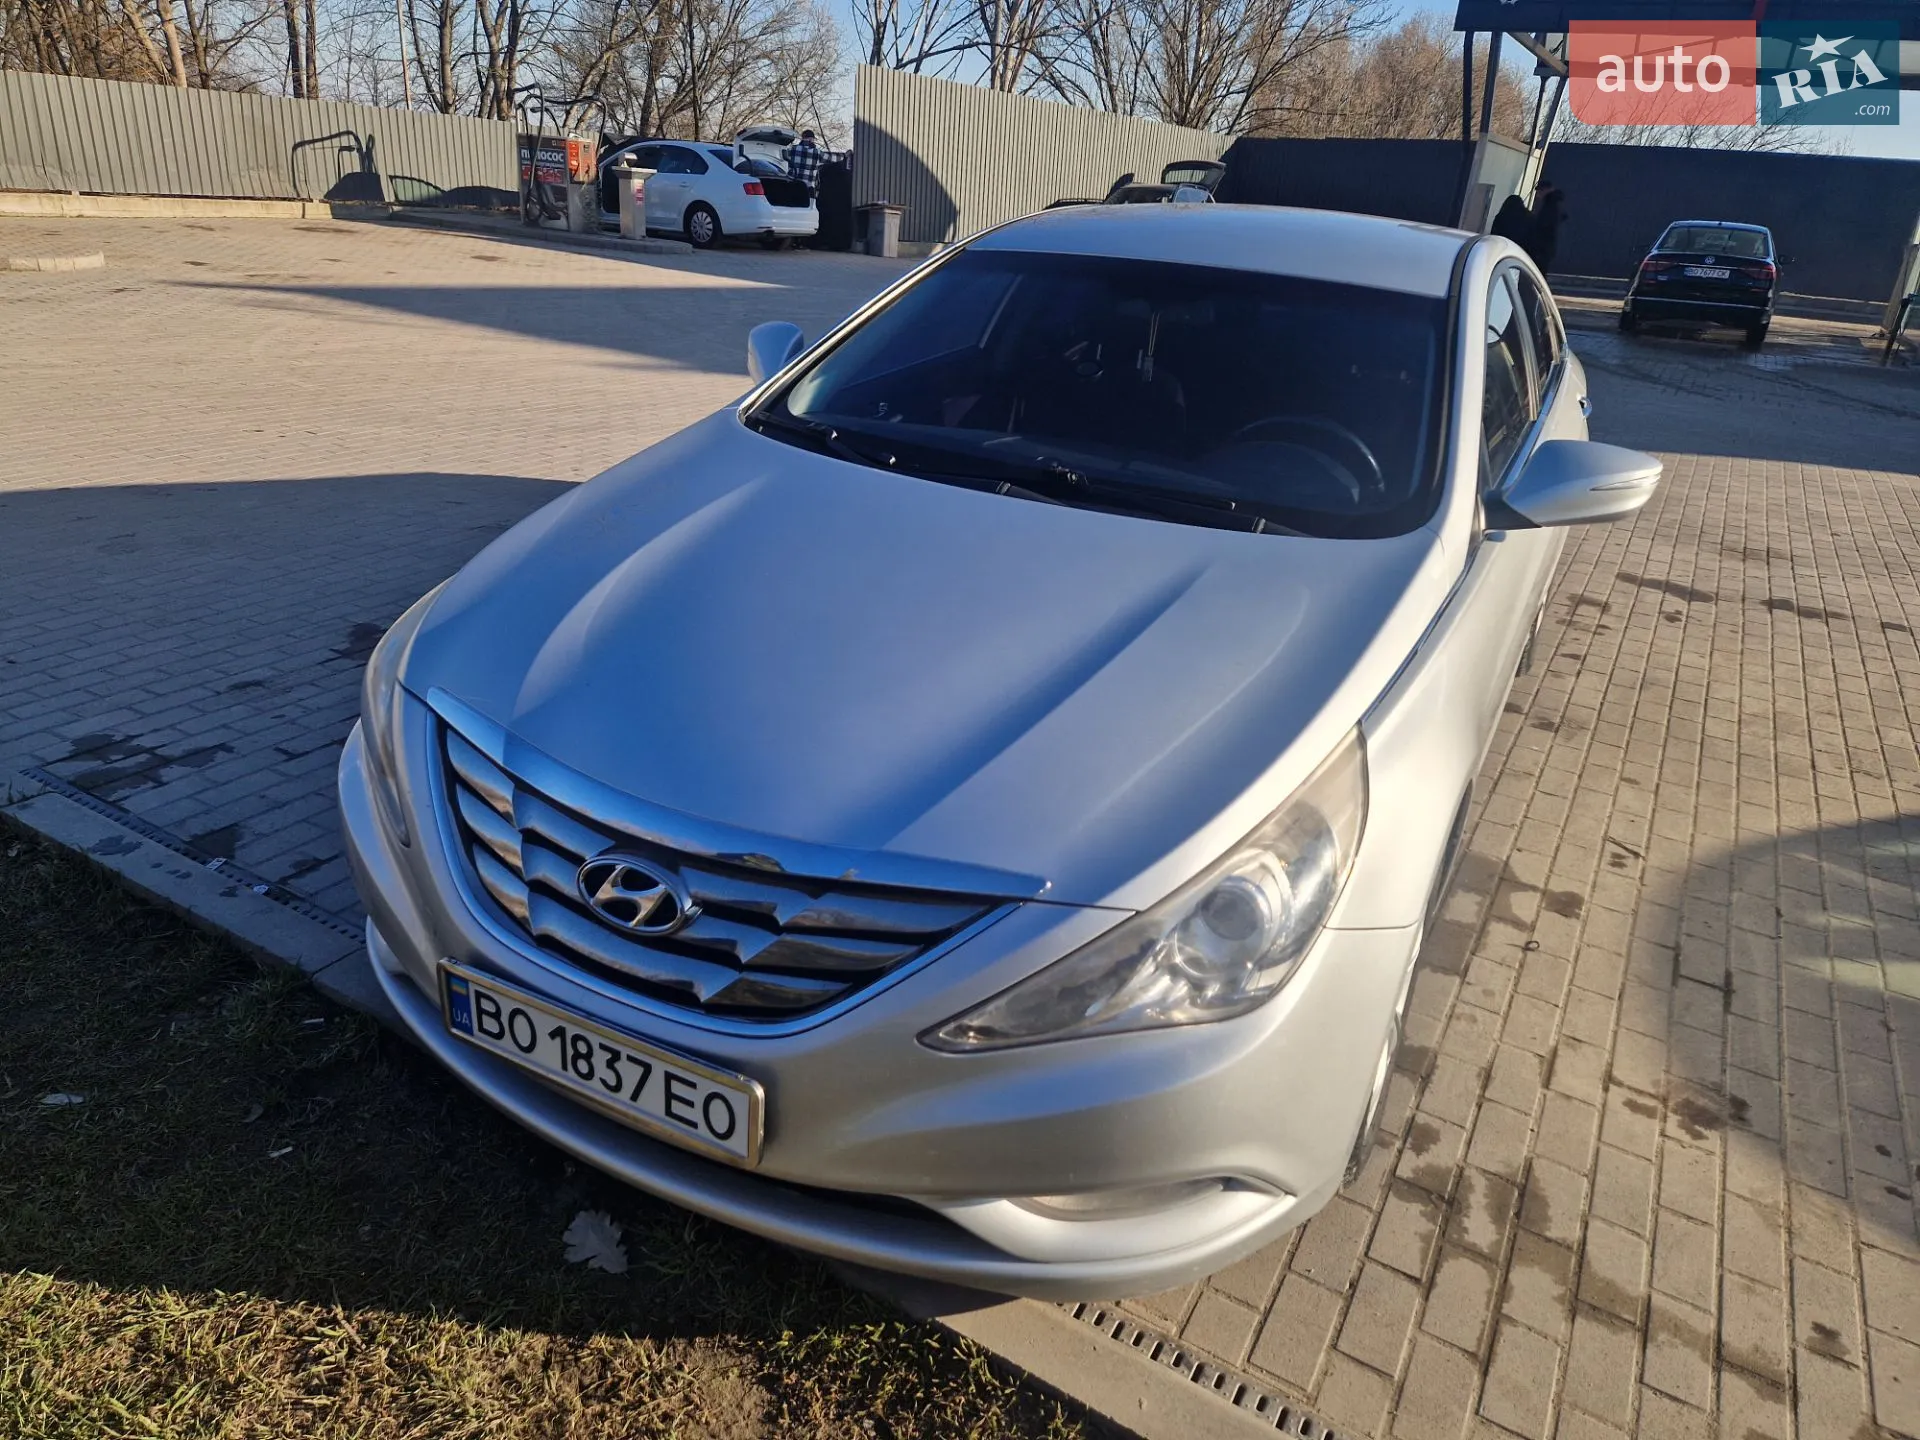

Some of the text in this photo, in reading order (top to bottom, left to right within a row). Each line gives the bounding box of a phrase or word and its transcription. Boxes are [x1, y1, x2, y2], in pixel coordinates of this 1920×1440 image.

[452, 1007, 471, 1027] UA
[474, 989, 736, 1141] BO 1837 EO
